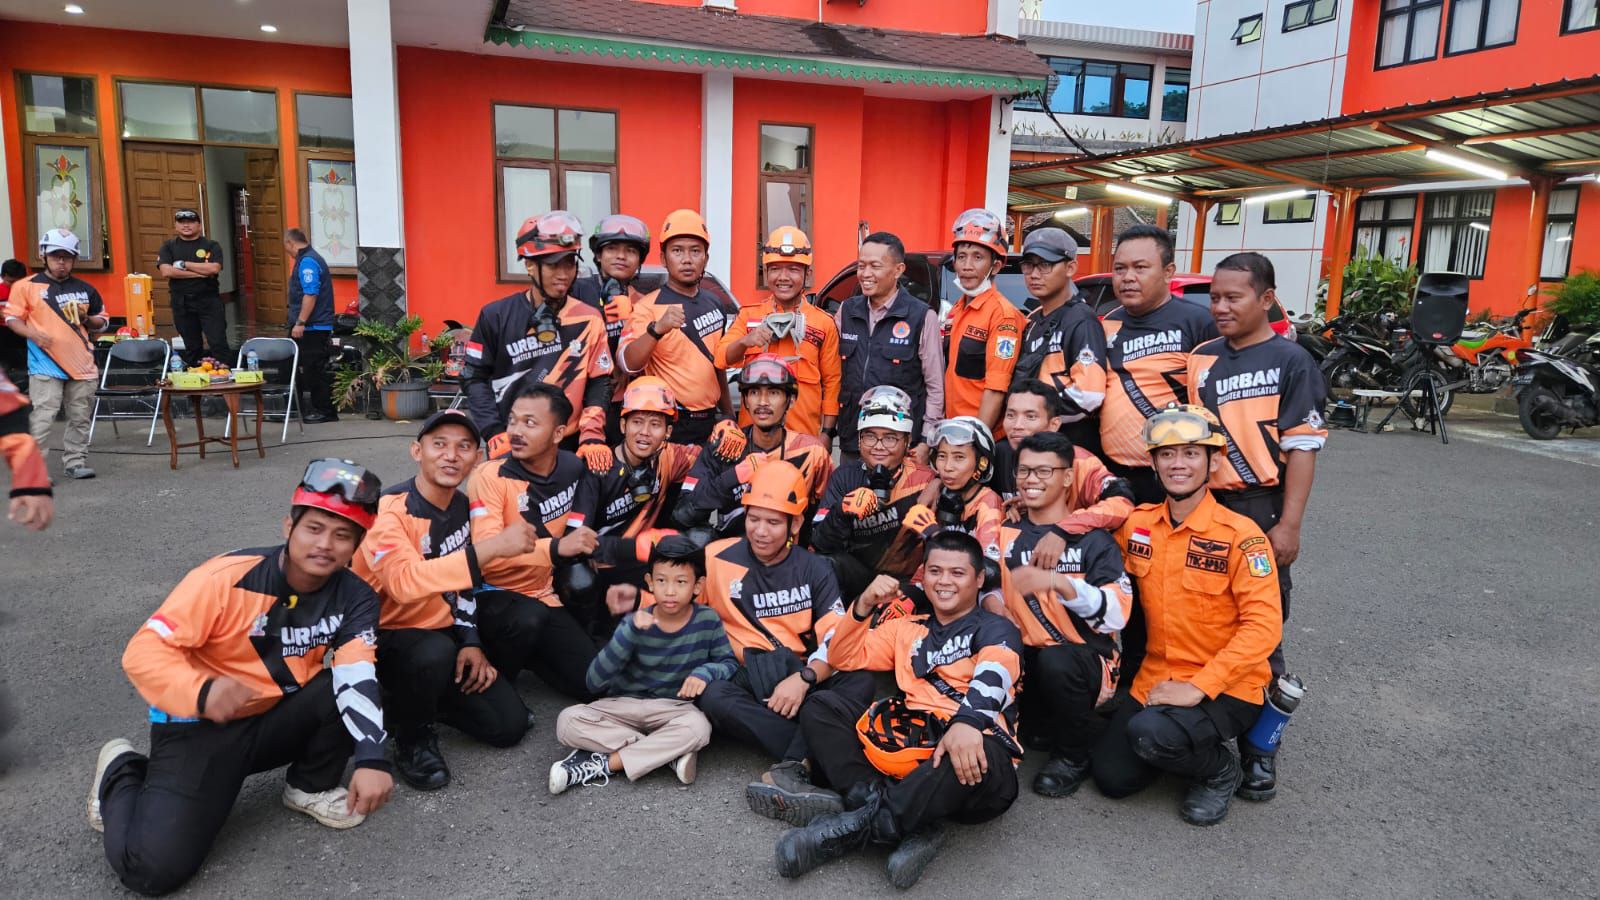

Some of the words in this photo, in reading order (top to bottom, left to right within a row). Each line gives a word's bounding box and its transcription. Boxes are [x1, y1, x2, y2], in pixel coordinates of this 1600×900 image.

[1122, 329, 1182, 354] URBAN
[1146, 344, 1182, 356] MITIGATION
[1216, 367, 1280, 395] URBAN
[1242, 386, 1279, 398] MITIGATIO
[753, 584, 812, 609] URBAN
[755, 608, 782, 618] DISASTER
[783, 600, 812, 614] MITIGATION
